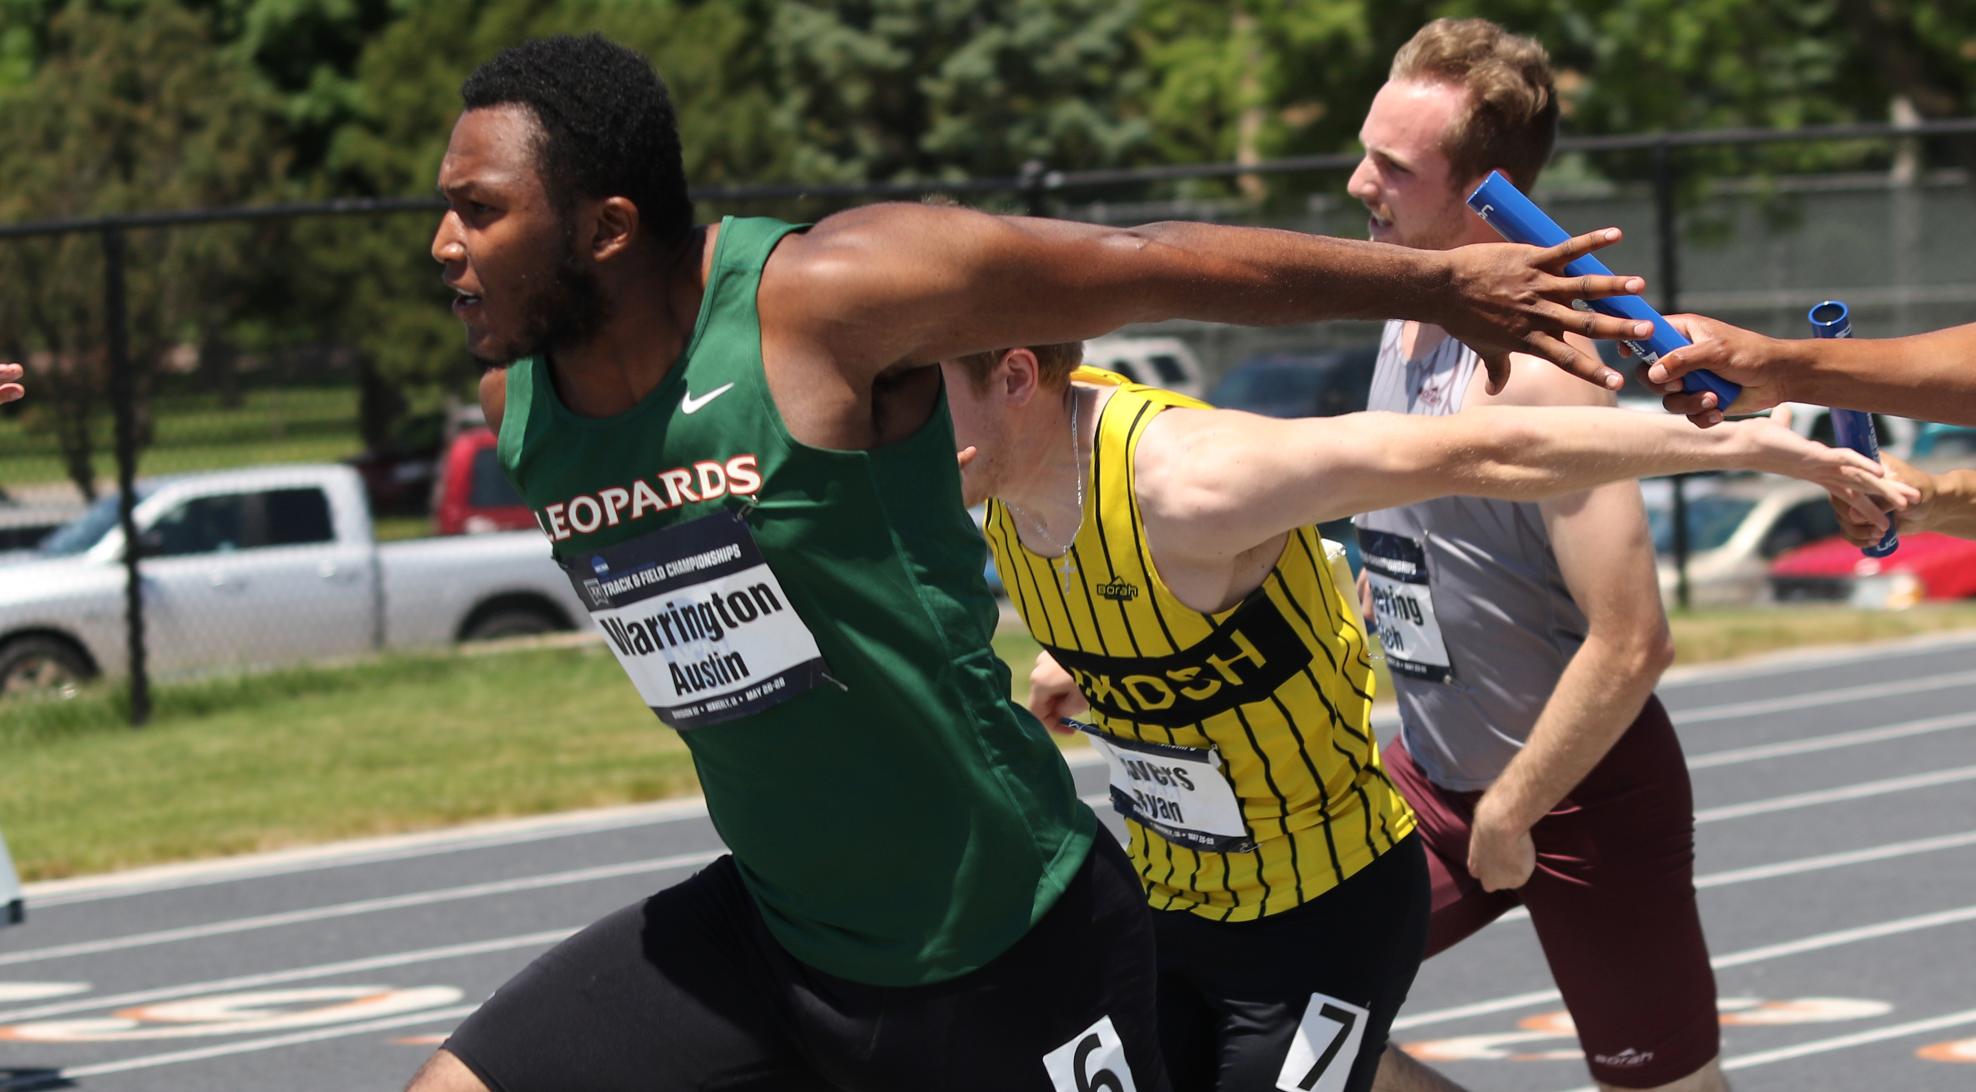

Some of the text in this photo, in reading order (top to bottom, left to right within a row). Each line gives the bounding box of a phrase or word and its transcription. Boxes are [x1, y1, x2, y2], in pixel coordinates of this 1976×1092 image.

[535, 454, 762, 542] LEOPARDS
[602, 577, 635, 597] TRACK
[640, 565, 666, 587] FIELD
[665, 543, 742, 577] CHAMPIONSHIPS
[599, 581, 783, 657] Warrington
[667, 651, 751, 697] Austin
[1073, 1032, 1125, 1092] 6
[1297, 1002, 1357, 1091] 7
